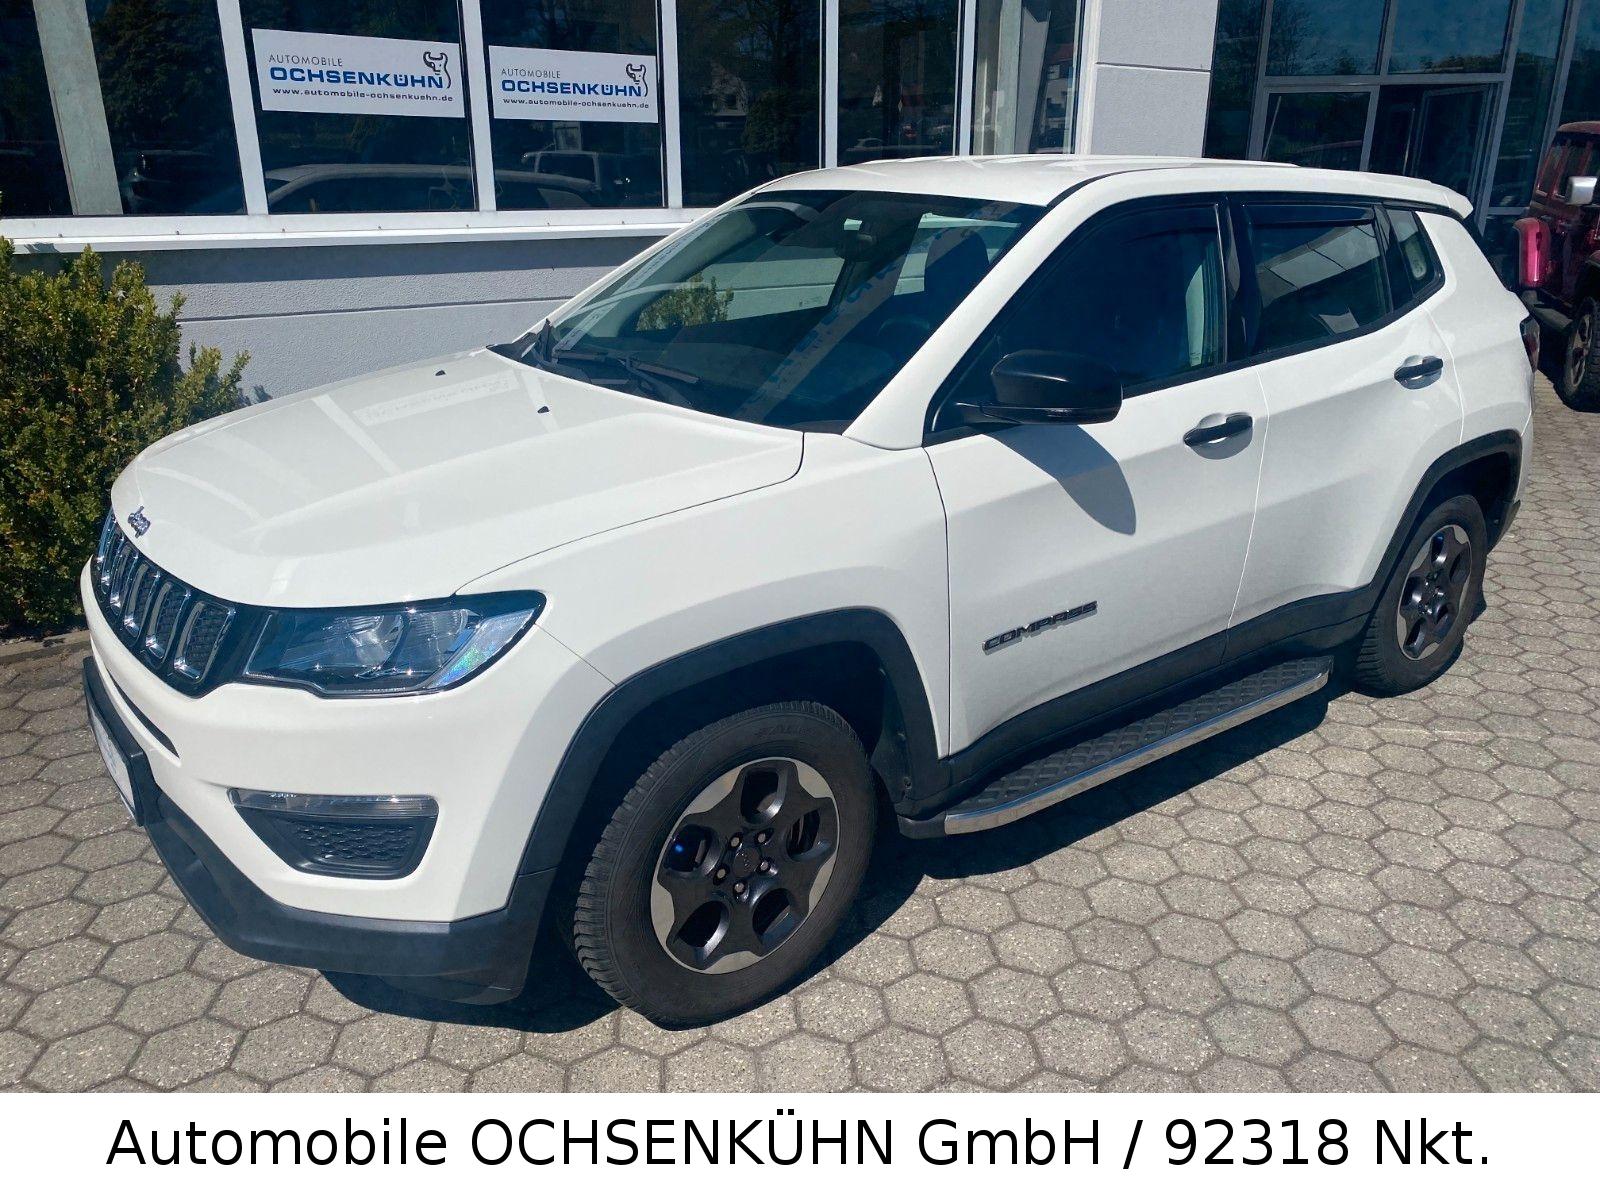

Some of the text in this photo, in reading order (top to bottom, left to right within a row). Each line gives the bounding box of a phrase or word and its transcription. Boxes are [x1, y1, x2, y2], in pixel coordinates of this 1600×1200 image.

[268, 54, 343, 67] AUTOMOBILE
[270, 66, 444, 89] OCHSENKÜHN
[501, 68, 561, 79] AUTOMOBILE
[272, 87, 453, 102] www.automobile-ochsenkuehn.de
[501, 79, 642, 97] OCHSENKÜHN
[503, 98, 649, 109] www.automobile-ochsenkuehn.de
